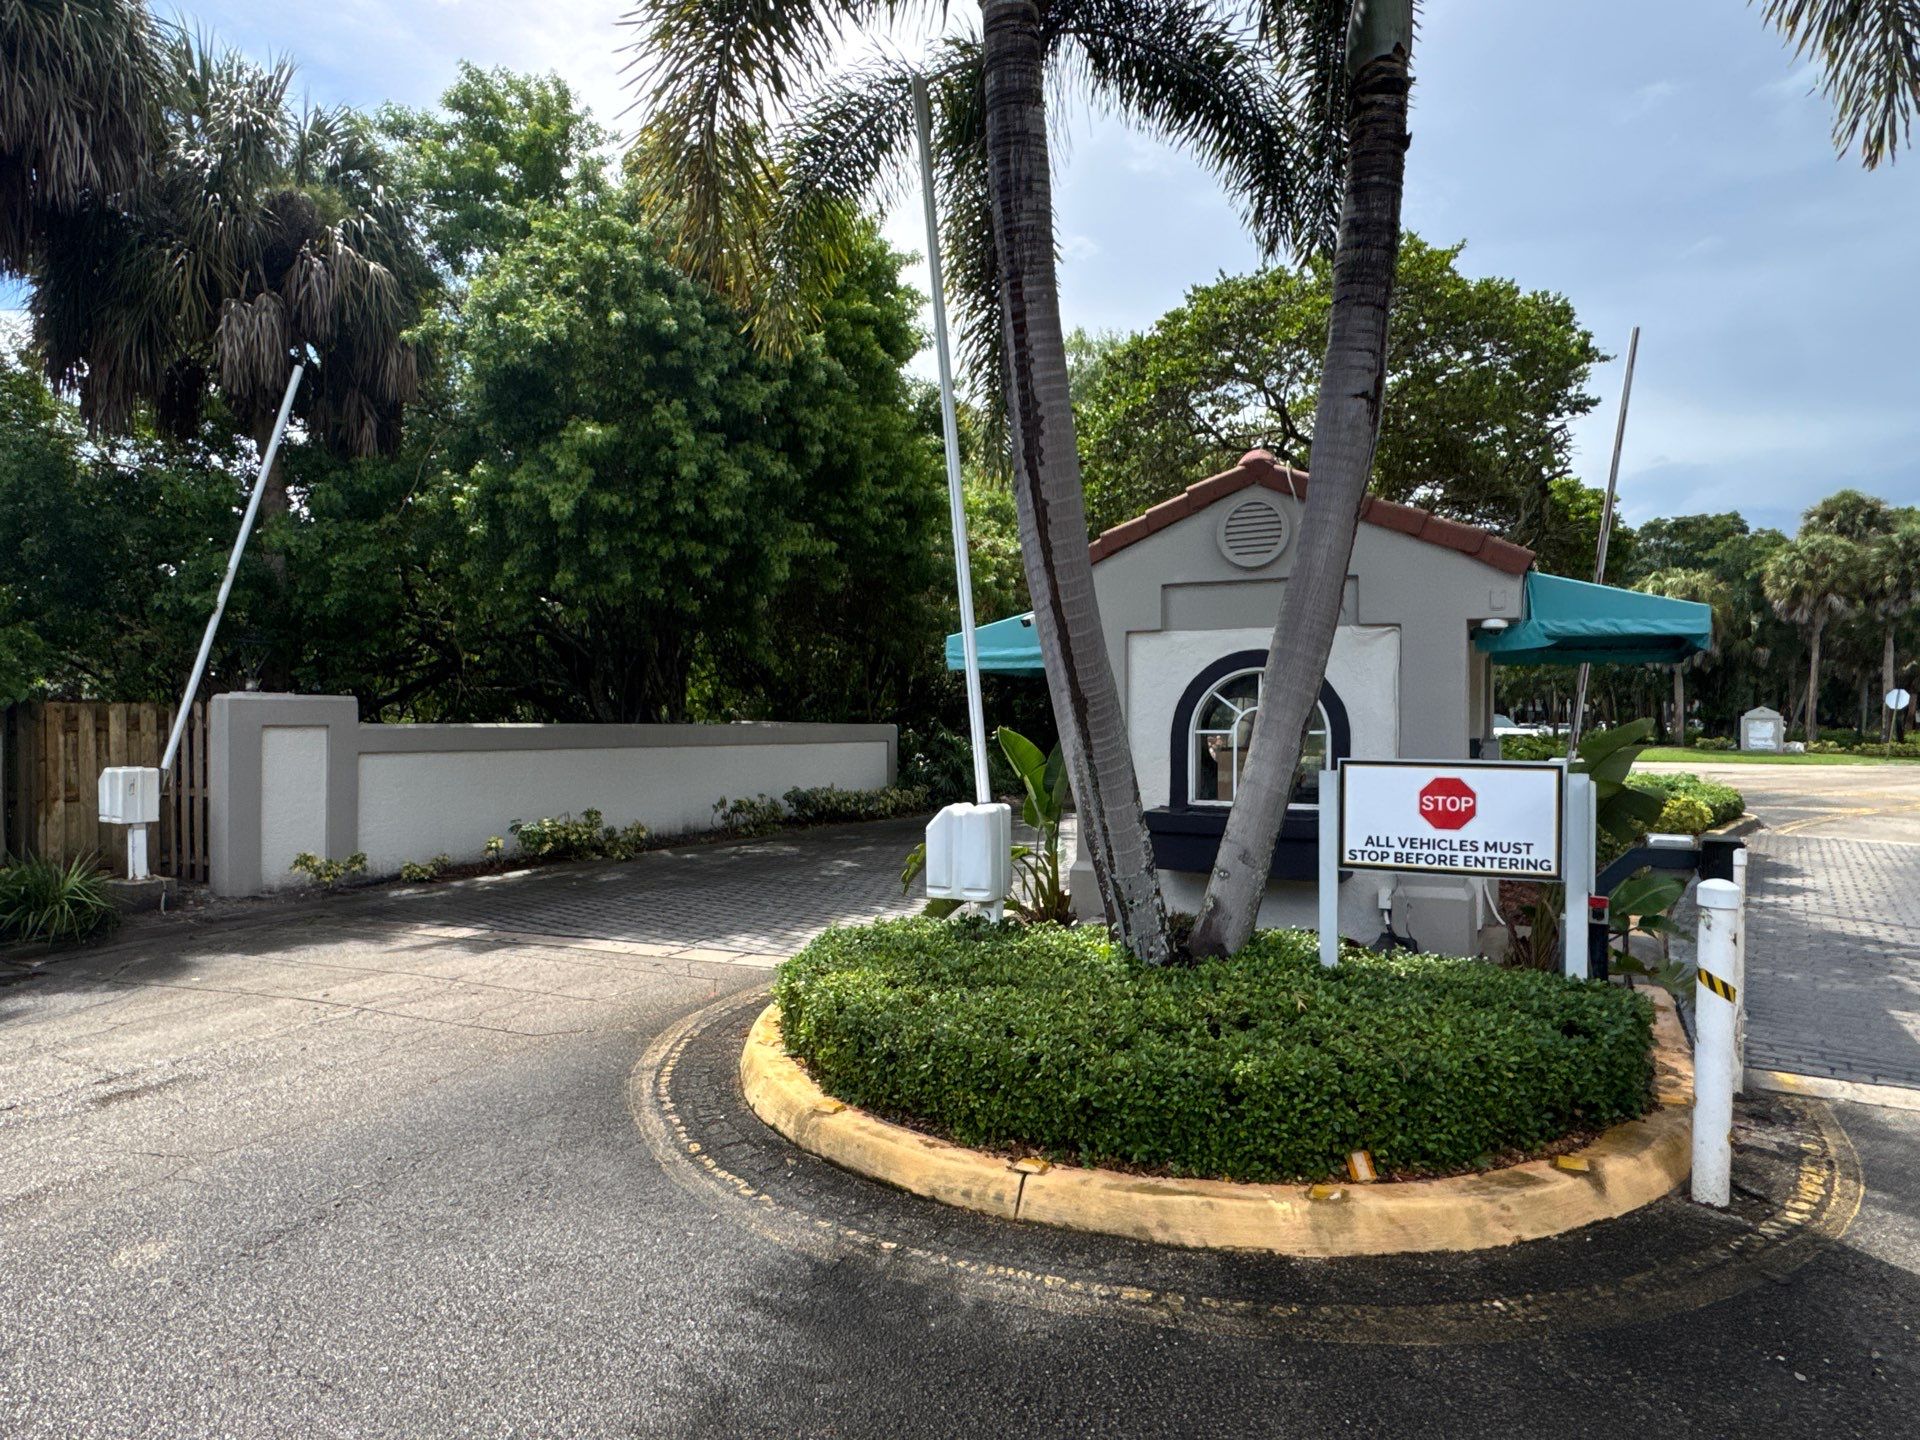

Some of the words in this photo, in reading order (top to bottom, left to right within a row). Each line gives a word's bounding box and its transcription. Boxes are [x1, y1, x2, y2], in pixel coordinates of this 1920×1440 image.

[1421, 795, 1474, 812] STOP
[1364, 835, 1395, 848] ALL
[1398, 836, 1479, 852] VEHICLES
[1484, 841, 1534, 855] MUST
[1348, 849, 1390, 862] STOP
[1394, 852, 1458, 867] BEFORE
[1463, 856, 1552, 871] ENTERING
